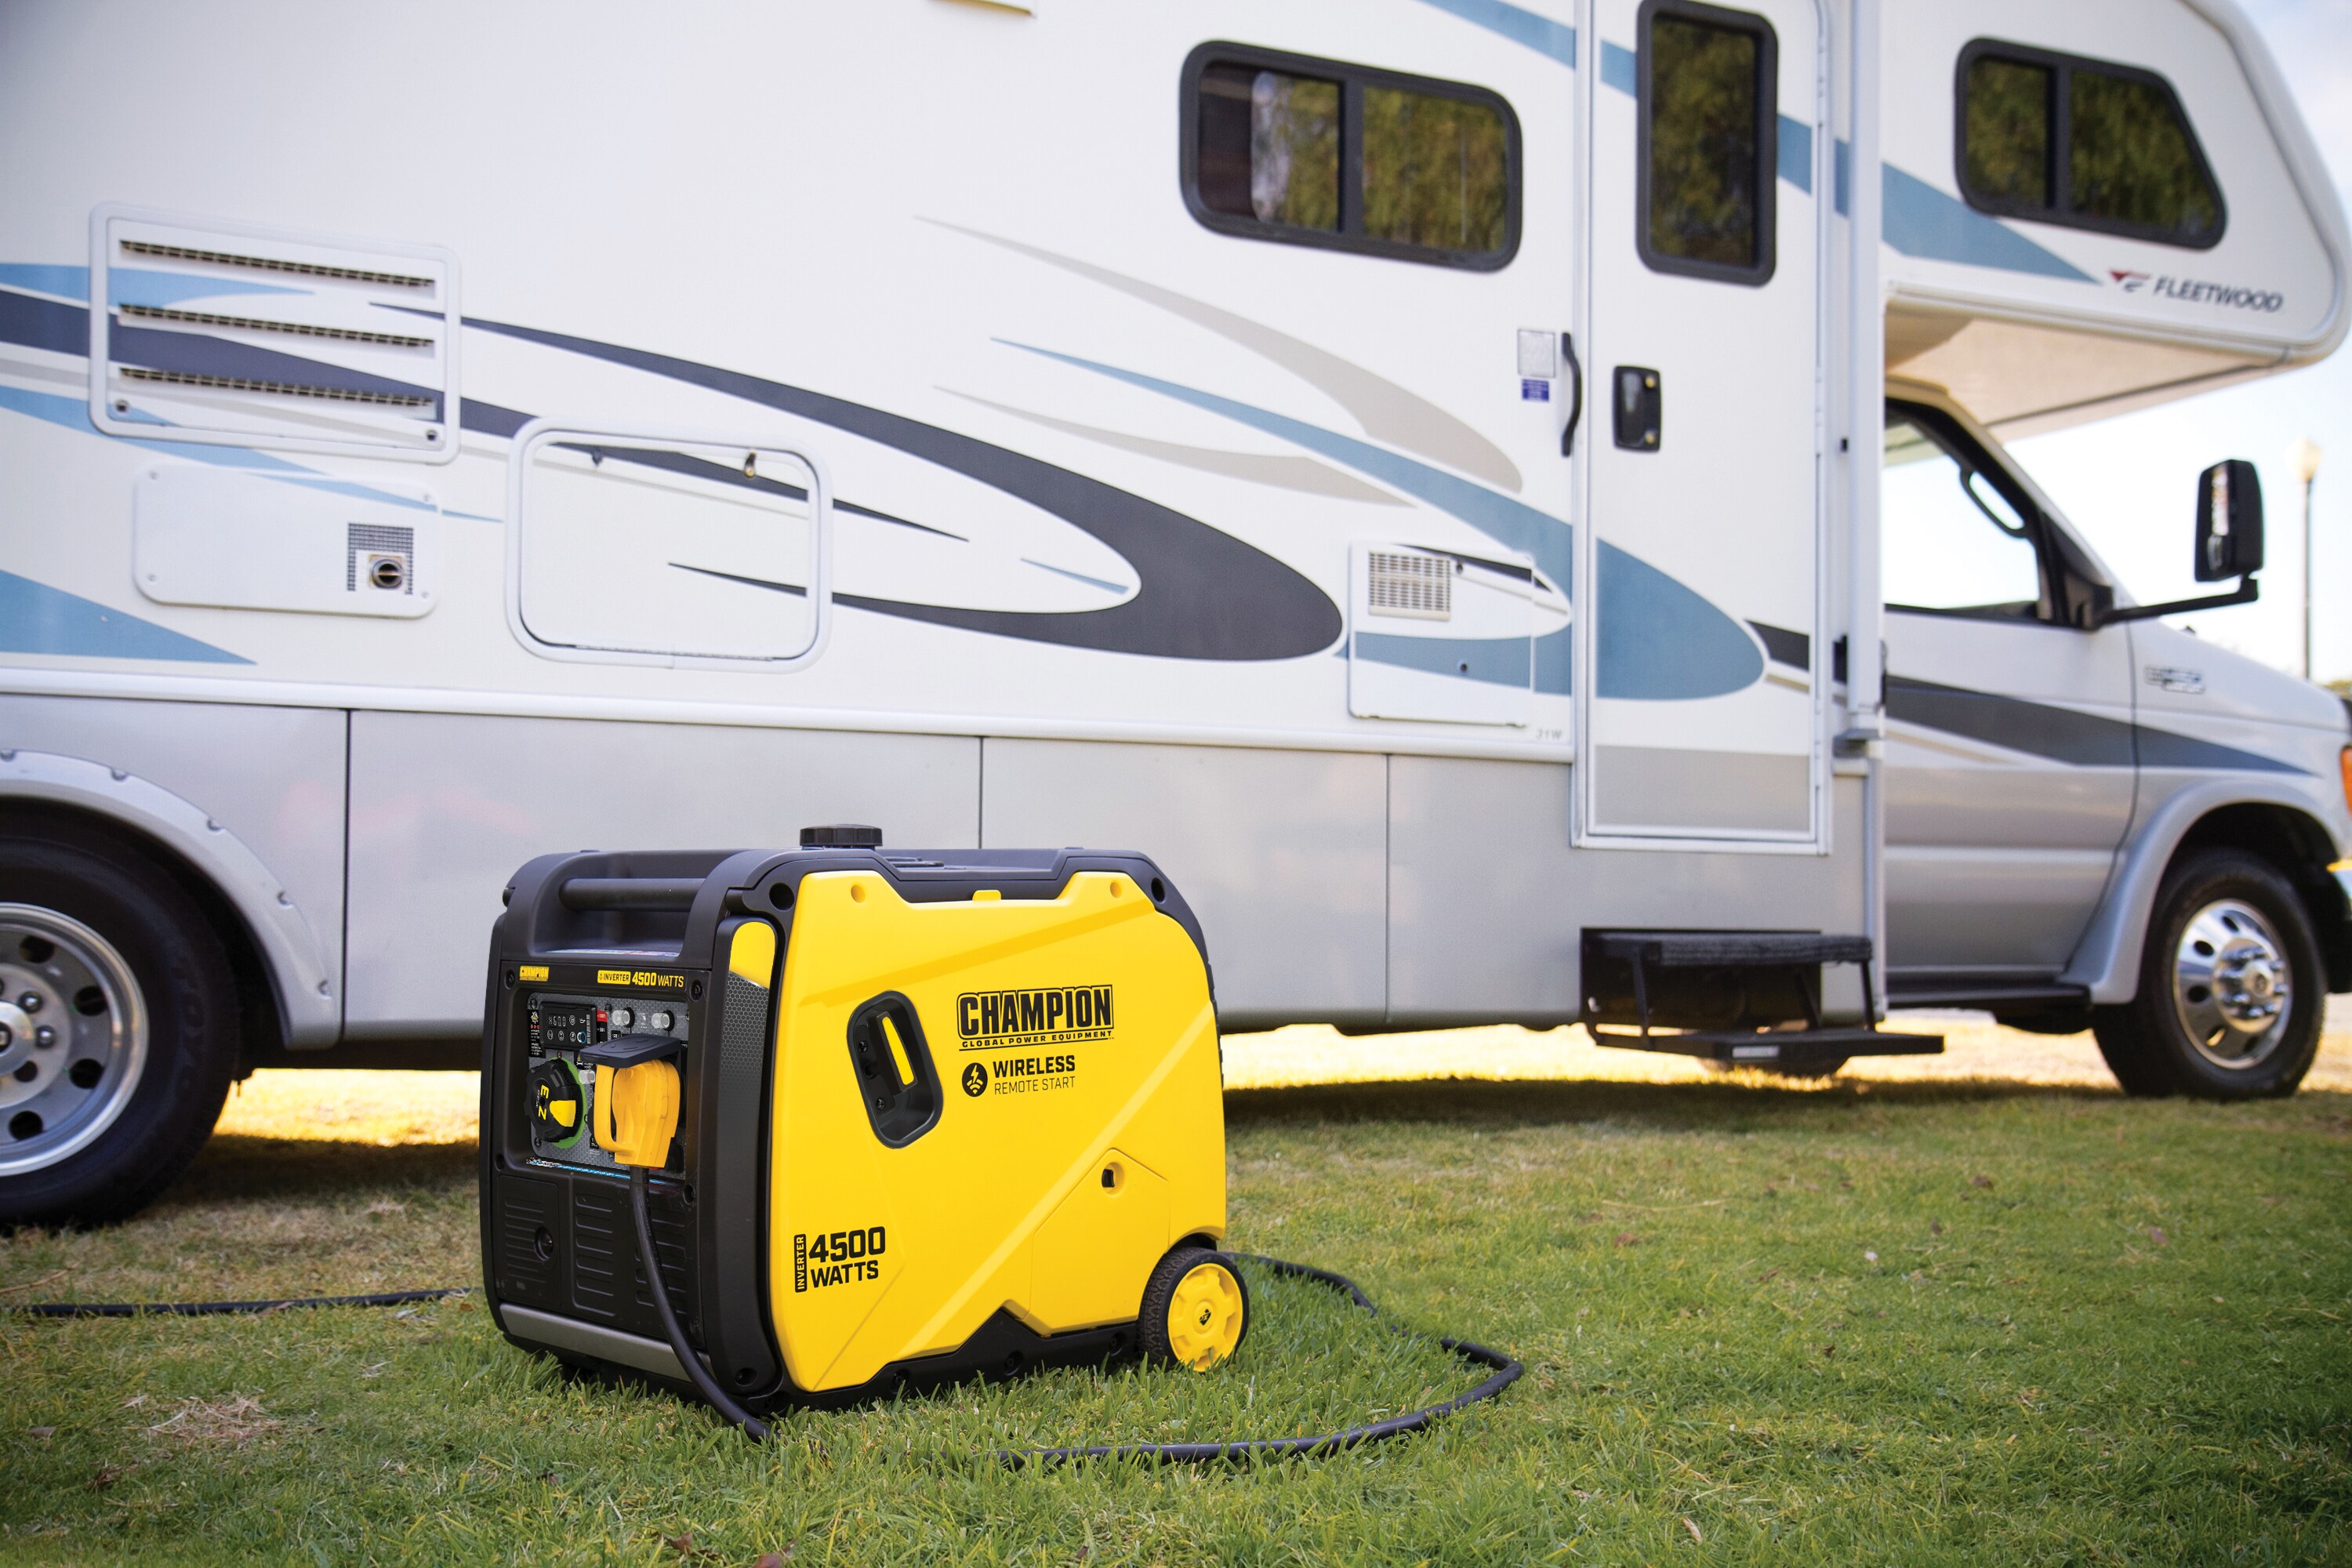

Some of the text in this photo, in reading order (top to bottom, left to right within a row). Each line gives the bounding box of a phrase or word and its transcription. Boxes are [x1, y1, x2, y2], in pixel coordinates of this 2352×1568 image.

[2153, 276, 2284, 312] FLEETWOOD
[520, 966, 549, 978] CHAMPION
[604, 971, 684, 988] INVERTER 4500 WATTS
[959, 989, 1112, 1036] CHAMPION
[962, 1030, 1112, 1048] GLOBAL POWER EQUIPMENT
[993, 1054, 1076, 1079] WIRELESS
[994, 1076, 1076, 1095] REMOTE START
[808, 1226, 886, 1263] 4500
[796, 1236, 805, 1290] INVERTER
[810, 1259, 879, 1288] WATTS
